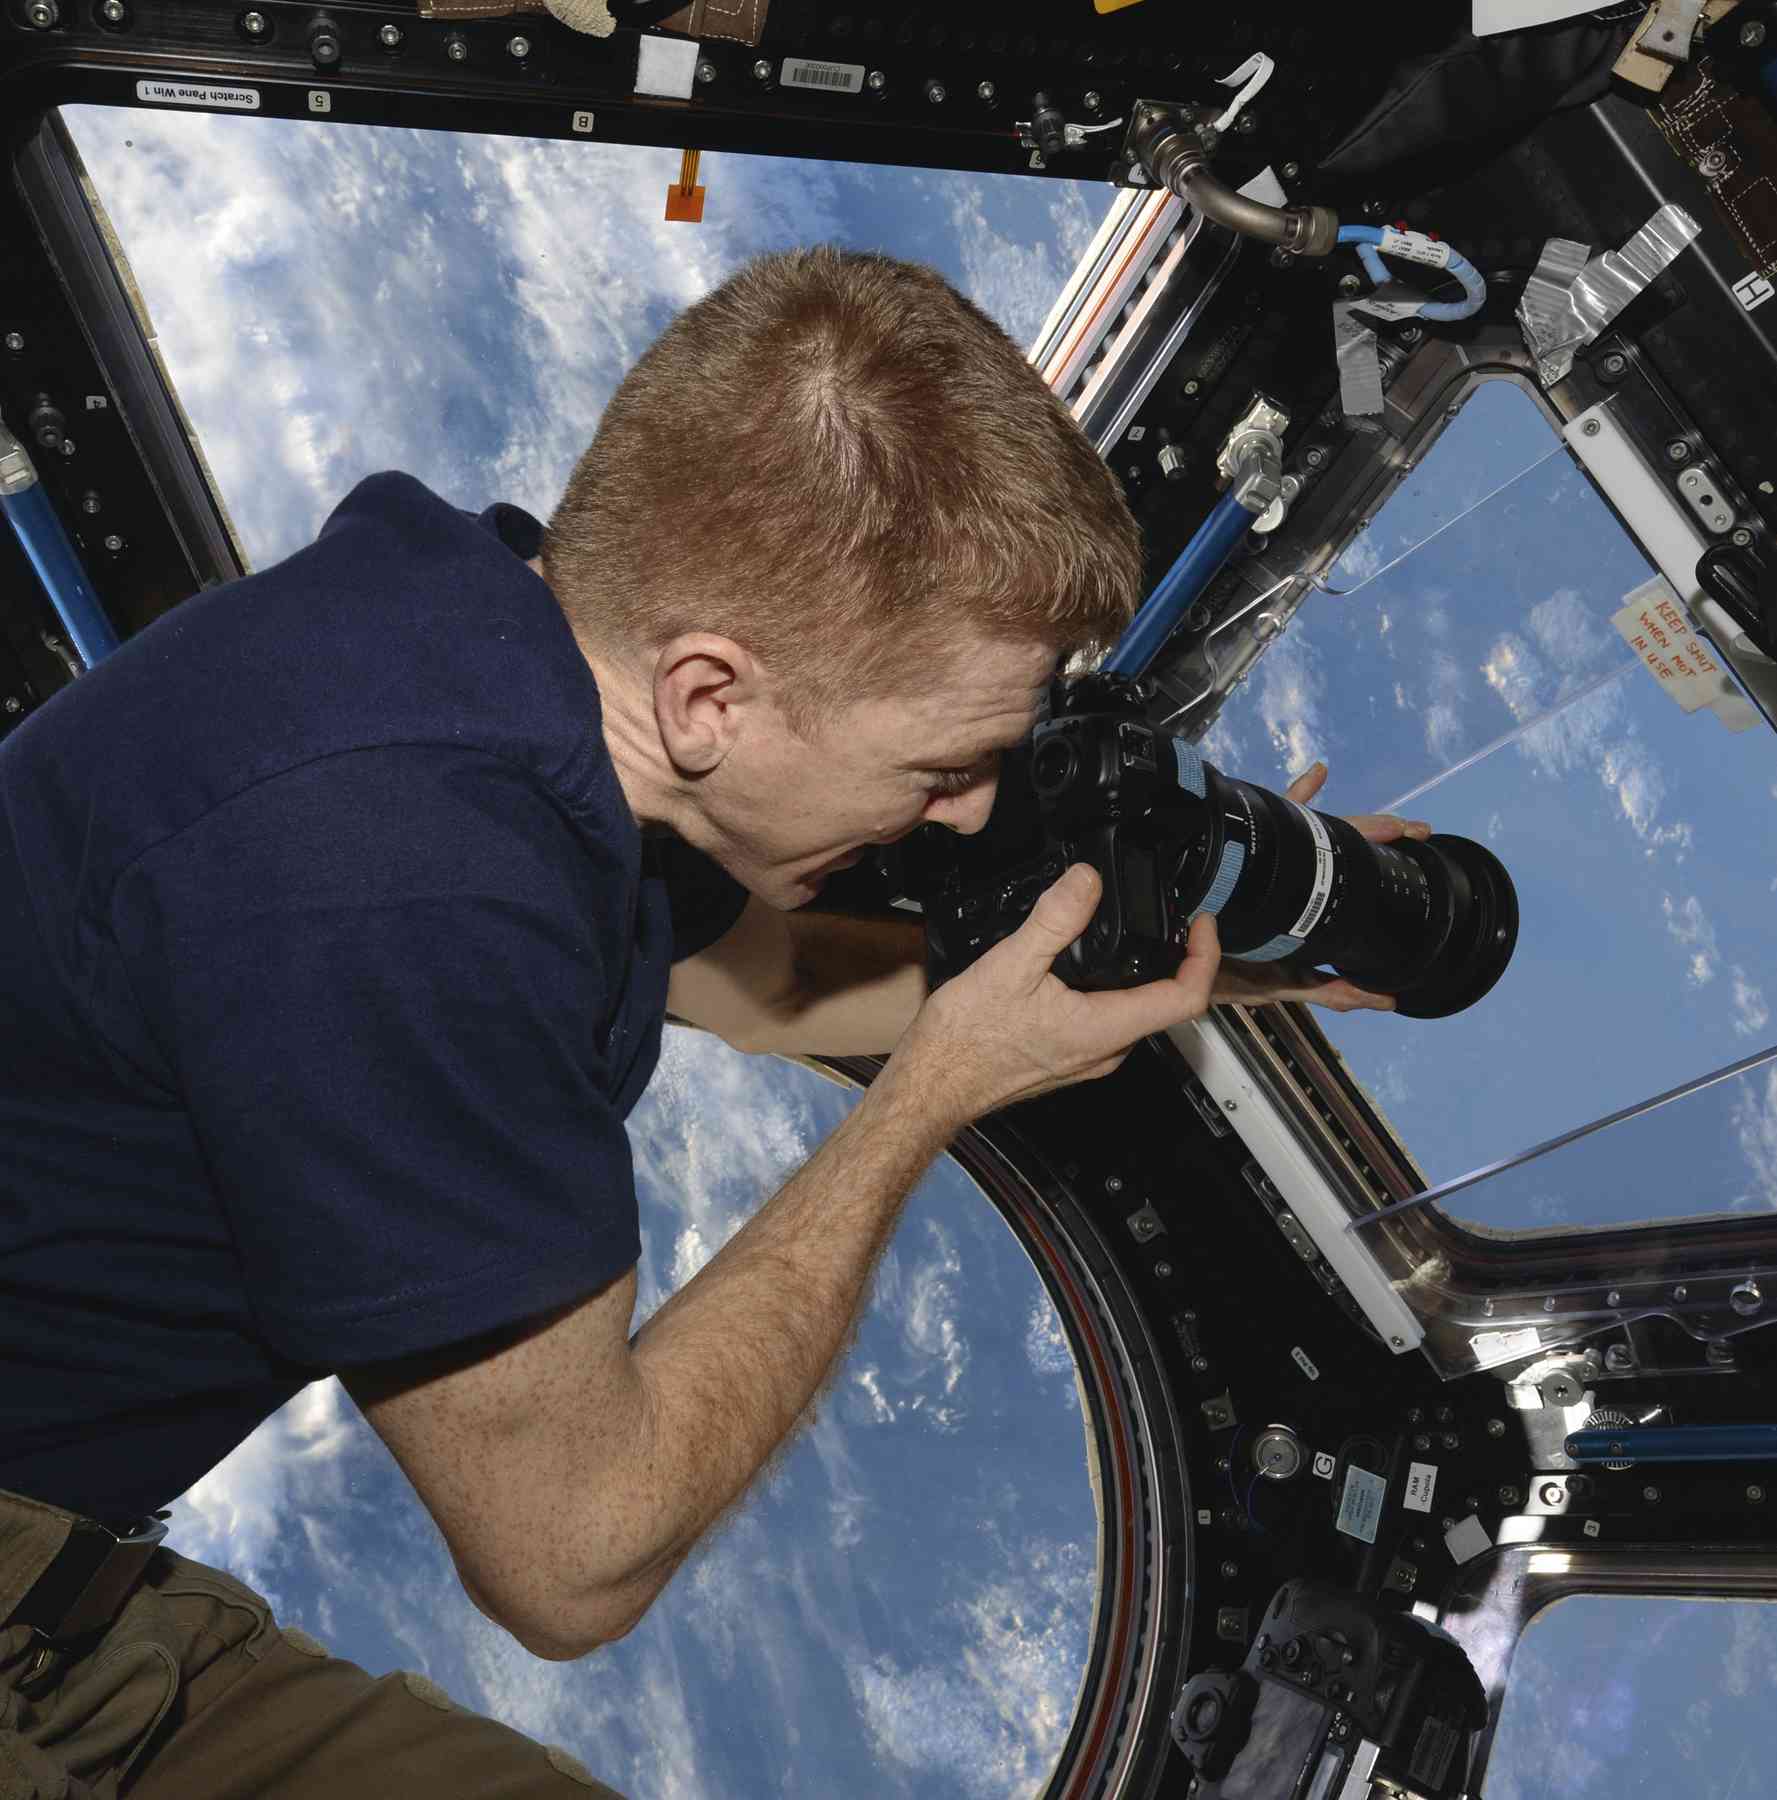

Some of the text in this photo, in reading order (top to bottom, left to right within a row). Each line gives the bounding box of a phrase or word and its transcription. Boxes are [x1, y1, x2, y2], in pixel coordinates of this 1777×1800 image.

[144, 86, 253, 104] Scratch Pane Win 1
[315, 95, 324, 108] 5
[578, 116, 590, 128] B
[1736, 276, 1770, 306] H
[1639, 612, 1697, 678] WHEN NOT
[1656, 600, 1718, 673] KEEP SHUT
[1631, 635, 1674, 680] IN USE
[1315, 1456, 1333, 1475] G
